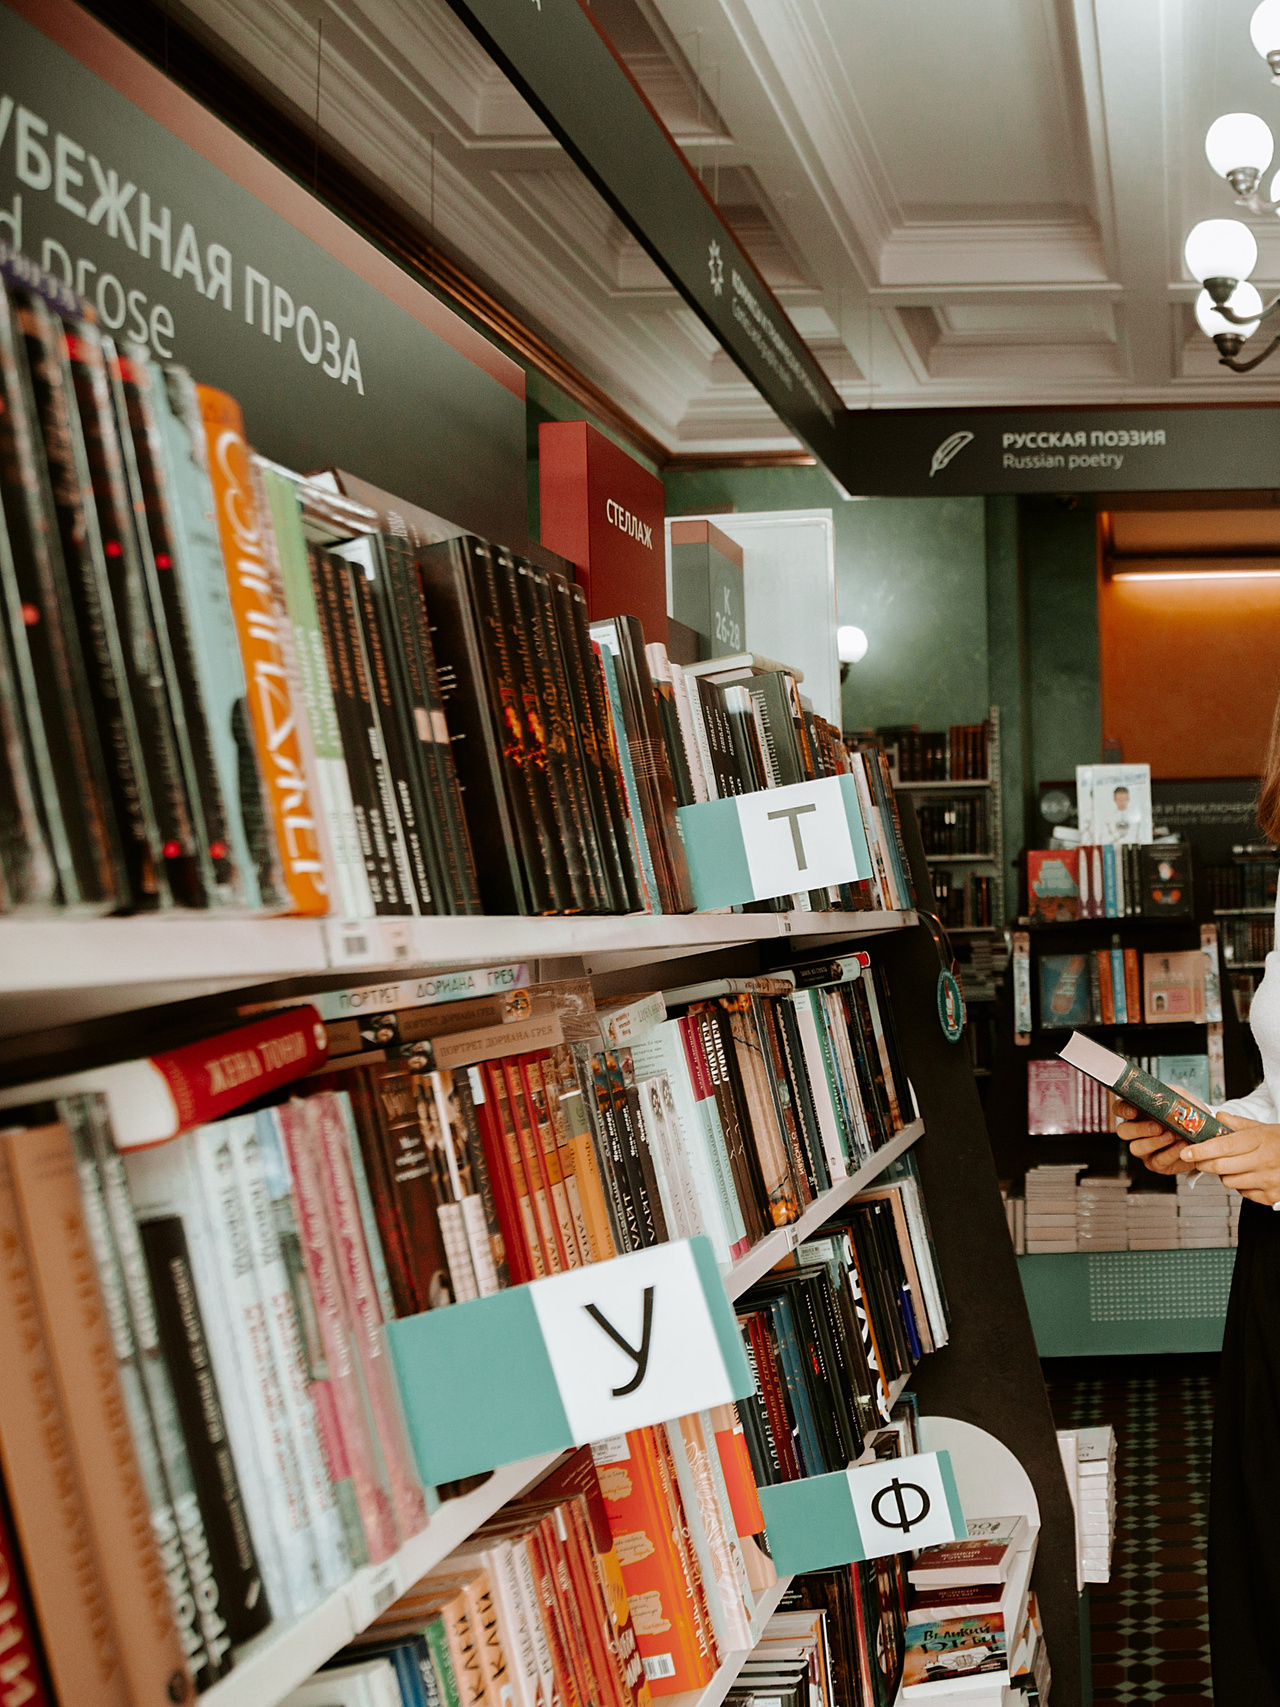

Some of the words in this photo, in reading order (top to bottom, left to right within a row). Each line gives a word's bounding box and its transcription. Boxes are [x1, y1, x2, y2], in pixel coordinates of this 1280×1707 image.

[244, 265, 365, 396] ПРОЗА
[1002, 430, 1087, 449] РУССКАЯ
[1090, 429, 1166, 447] ПОЭЗИЯ
[1003, 452, 1065, 469] Russian
[1068, 452, 1124, 470] poetry
[606, 498, 653, 550] СТЕЛЛАЖ
[715, 611, 741, 651] 26-28
[767, 803, 816, 871] Т
[339, 985, 399, 1010] ПОРТРЕТ
[416, 975, 475, 999] ДОРИАНА
[487, 968, 516, 987] ГРЕЯ
[439, 1039, 483, 1058] ПОРТРЕТ
[485, 1031, 530, 1052] ДОРИАНА
[531, 1024, 554, 1042] ГРЕЯ
[622, 1192, 640, 1249] УАЙТ
[638, 1187, 657, 1242] УАЙТ
[584, 1285, 655, 1397] У
[744, 1340, 767, 1406] БЕРЛИНЕ
[767, 1427, 781, 1471] ОДИН
[871, 1478, 930, 1534] Ф
